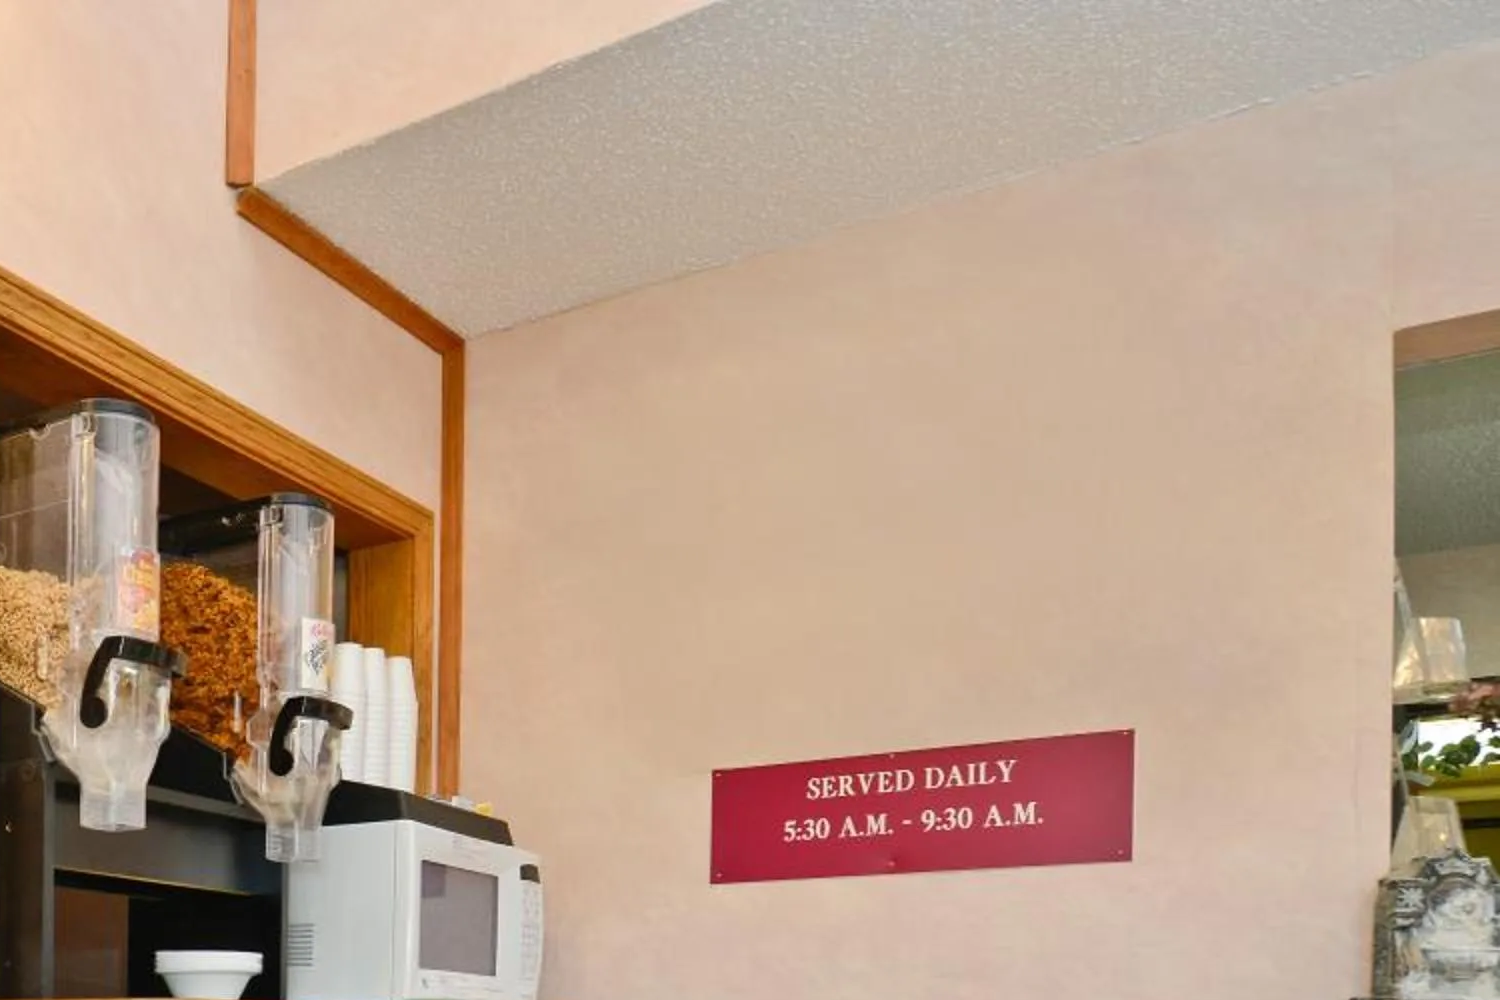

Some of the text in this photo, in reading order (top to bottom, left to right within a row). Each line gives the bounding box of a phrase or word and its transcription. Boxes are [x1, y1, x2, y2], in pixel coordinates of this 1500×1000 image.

[806, 759, 1018, 800] SERVED DAILY
[783, 816, 831, 842] 5:30
[838, 813, 894, 838] A.M.
[920, 807, 973, 833] 9:30
[984, 802, 1044, 828] A.M.
